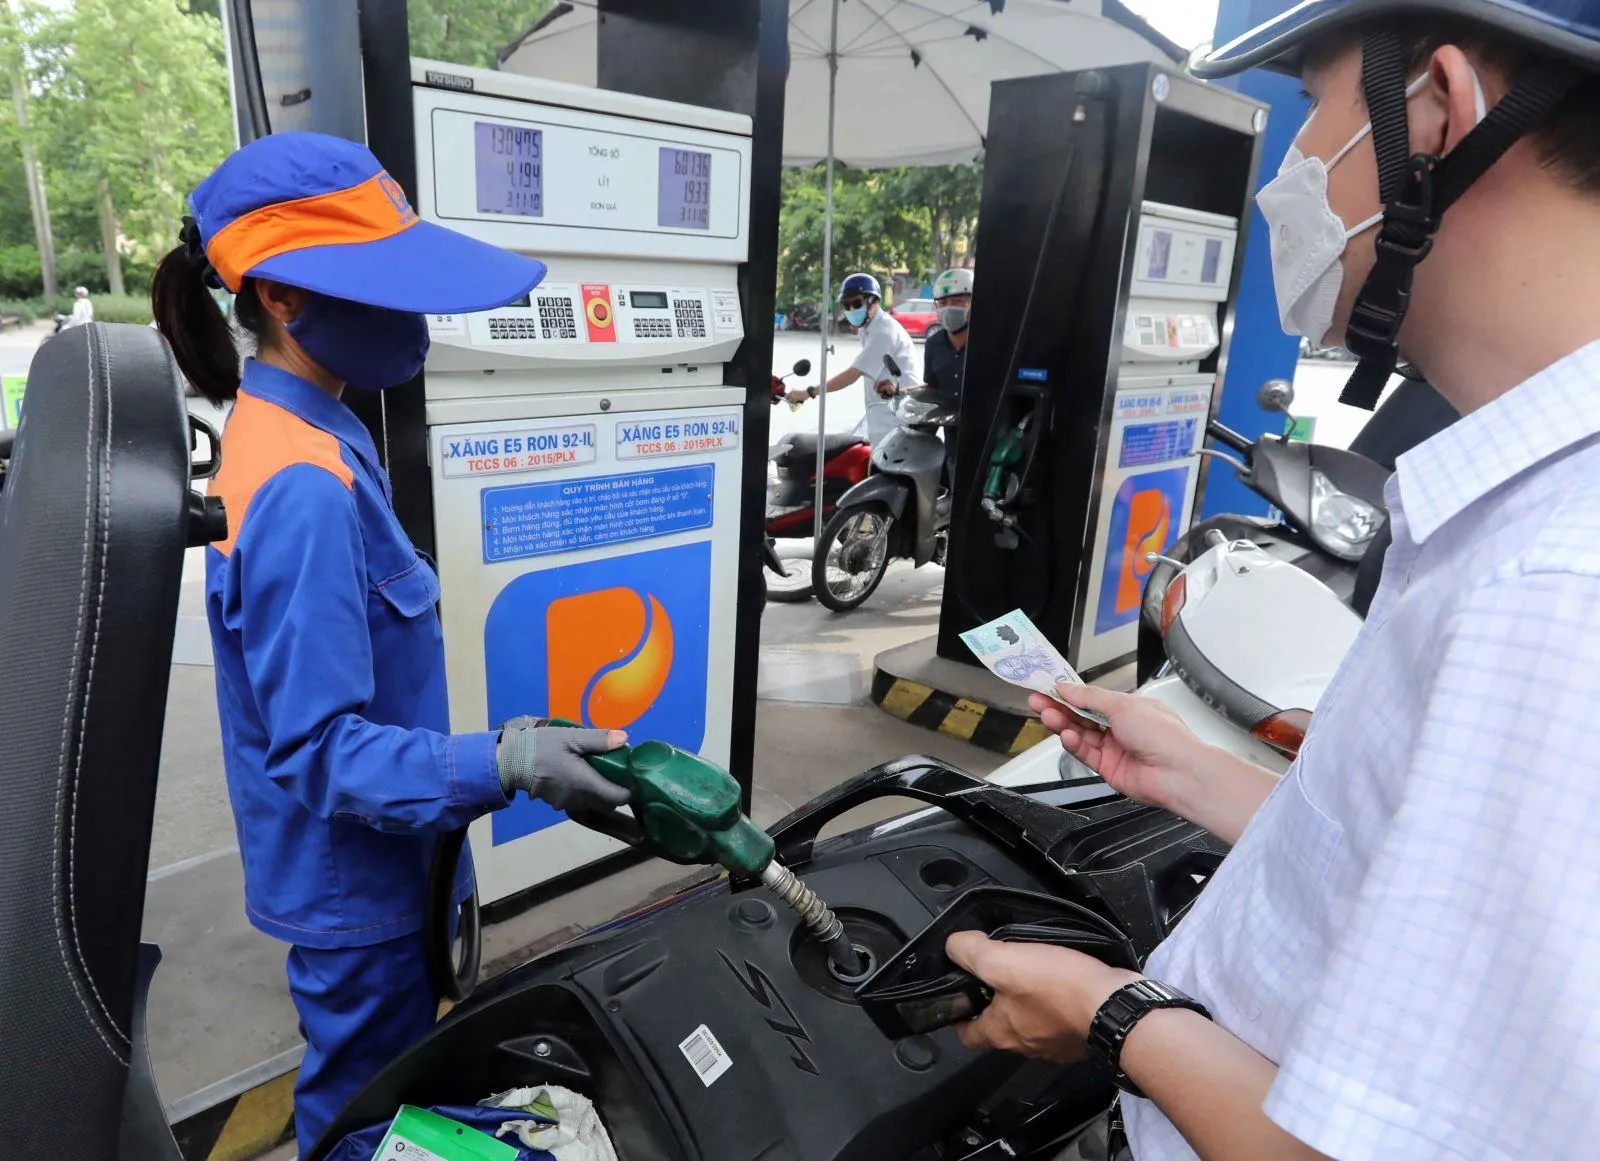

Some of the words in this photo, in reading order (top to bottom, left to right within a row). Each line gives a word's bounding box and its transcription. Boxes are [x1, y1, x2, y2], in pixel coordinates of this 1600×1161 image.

[428, 72, 472, 88] TATSUNO
[622, 425, 661, 442] XĂNG
[665, 425, 680, 438] E5
[684, 422, 709, 437] RON
[450, 438, 498, 458] XĂNG
[504, 438, 522, 454] E5
[527, 435, 558, 451] RON
[562, 431, 591, 447] 92-II
[636, 443, 661, 454] TCCS
[664, 442, 675, 452] 06
[684, 437, 723, 450] 2015/PLX
[467, 458, 500, 471] TCCS
[504, 456, 517, 468] 06
[528, 450, 576, 465] 2015/PLX
[563, 486, 581, 494] QUY
[1170, 655, 1228, 718] HONDA
